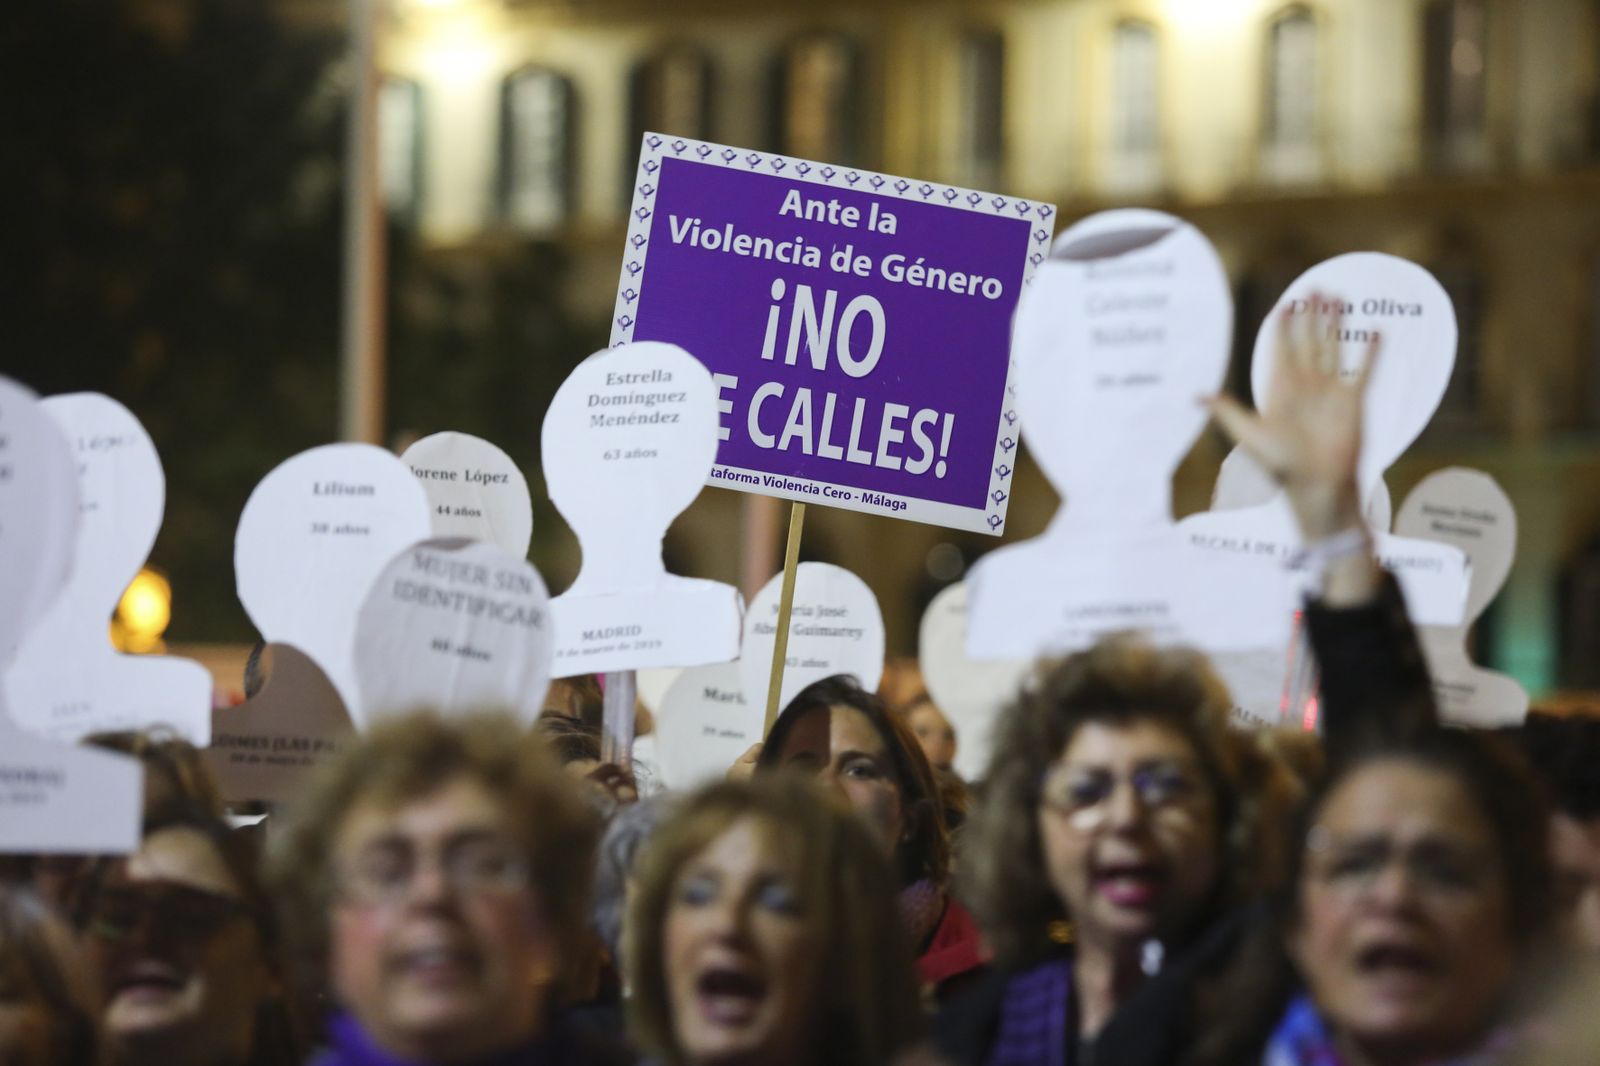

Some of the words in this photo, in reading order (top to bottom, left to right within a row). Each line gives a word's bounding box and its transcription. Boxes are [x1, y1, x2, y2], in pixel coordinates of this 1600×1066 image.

[778, 188, 860, 229] Ante
[867, 201, 899, 236] la
[667, 214, 822, 269] Violencia
[829, 244, 873, 278] de
[880, 255, 1004, 301] Género
[1361, 299, 1423, 317] Oliva
[760, 277, 887, 379] ¡NO
[605, 368, 673, 387] Estrella
[587, 390, 688, 409] Domínguez
[589, 410, 681, 429] Menéndez
[713, 373, 739, 442] E
[747, 381, 955, 479] CALLES!
[624, 447, 659, 460] años
[464, 469, 509, 487] López
[710, 466, 760, 486] taforma
[763, 474, 820, 497] Violencia
[822, 485, 851, 502] Cero
[861, 491, 908, 512] Málaga
[436, 504, 452, 516] 44
[453, 505, 483, 519] años
[581, 624, 643, 641] MADRID
